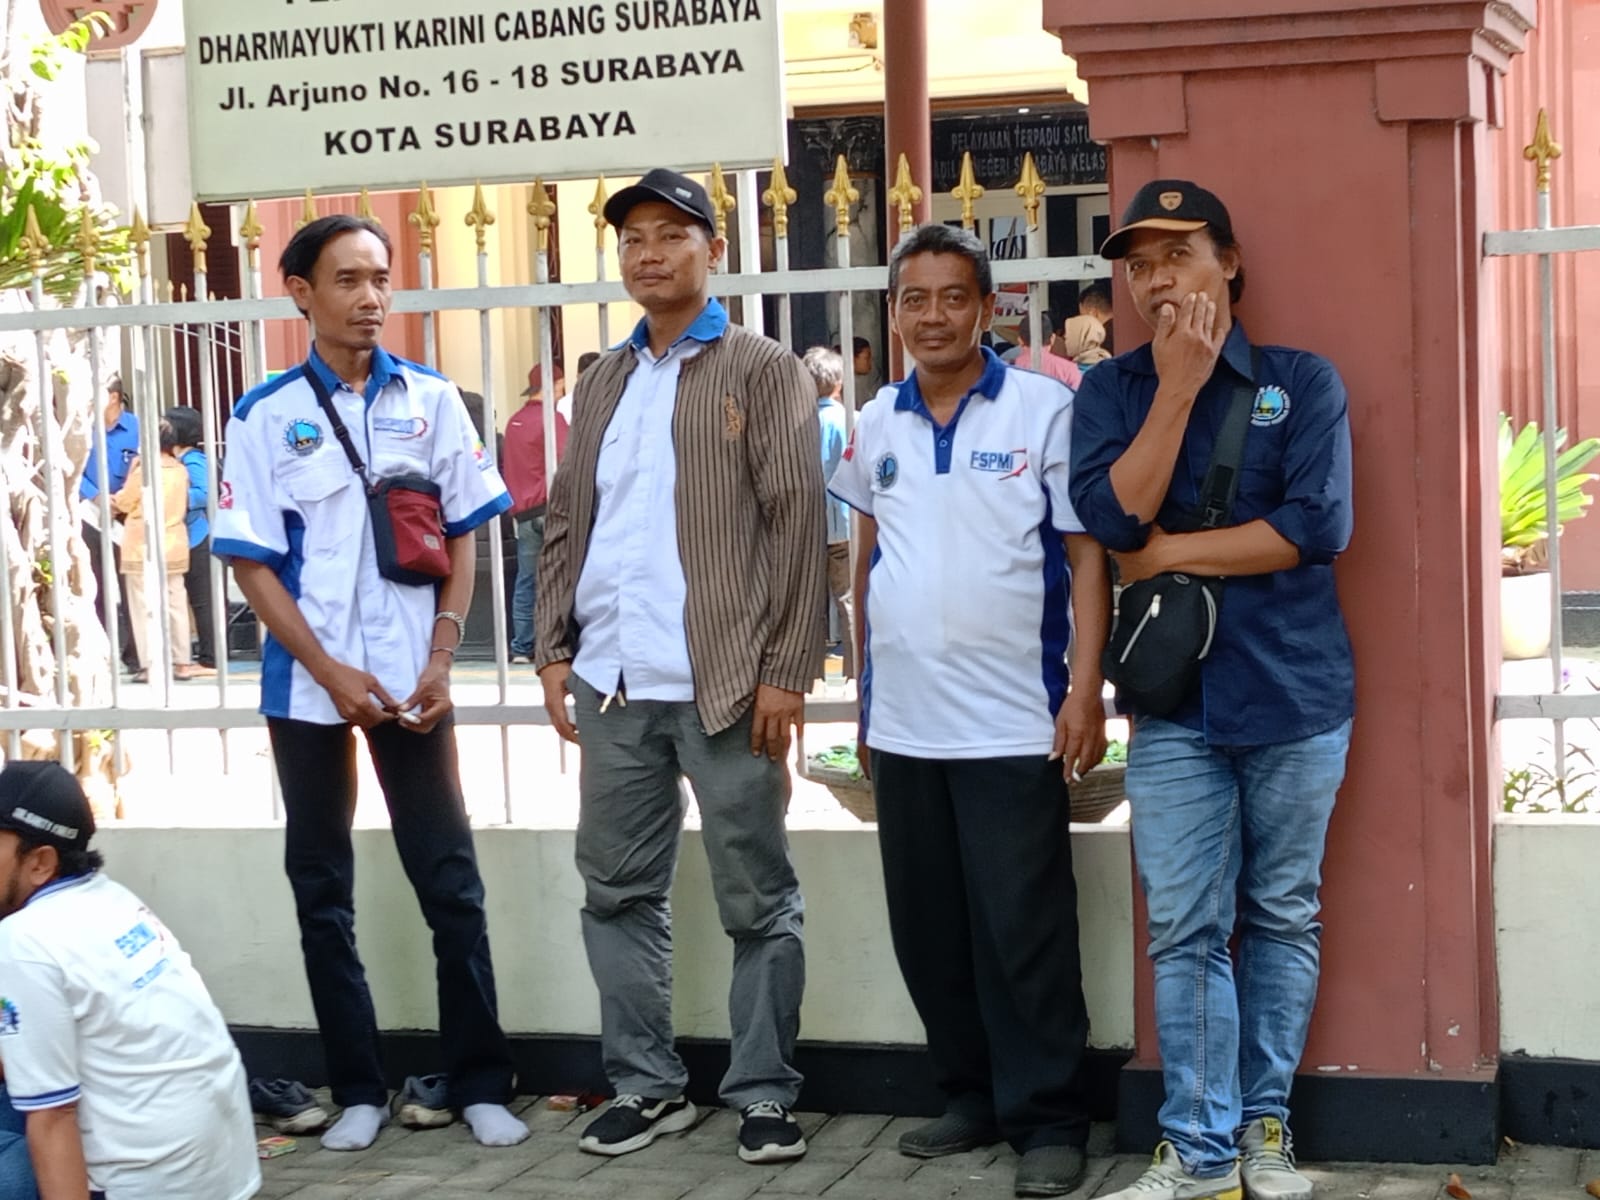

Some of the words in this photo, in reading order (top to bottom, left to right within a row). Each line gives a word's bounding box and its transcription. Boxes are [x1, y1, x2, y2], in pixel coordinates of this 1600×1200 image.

[199, 22, 385, 65] DHARMAYUKTI
[394, 14, 485, 50] KARINI
[494, 4, 606, 43] CABANG
[615, 0, 761, 33] SURABAYA
[219, 86, 254, 112] Jl.
[267, 81, 367, 112] Arjuno
[379, 75, 430, 100] No.
[443, 69, 481, 95] 16
[511, 64, 548, 90] 18
[561, 49, 744, 87] SURABAYA
[324, 126, 421, 157] KOTA
[435, 111, 636, 149] SURABAYA
[970, 450, 1013, 470] FSPMI
